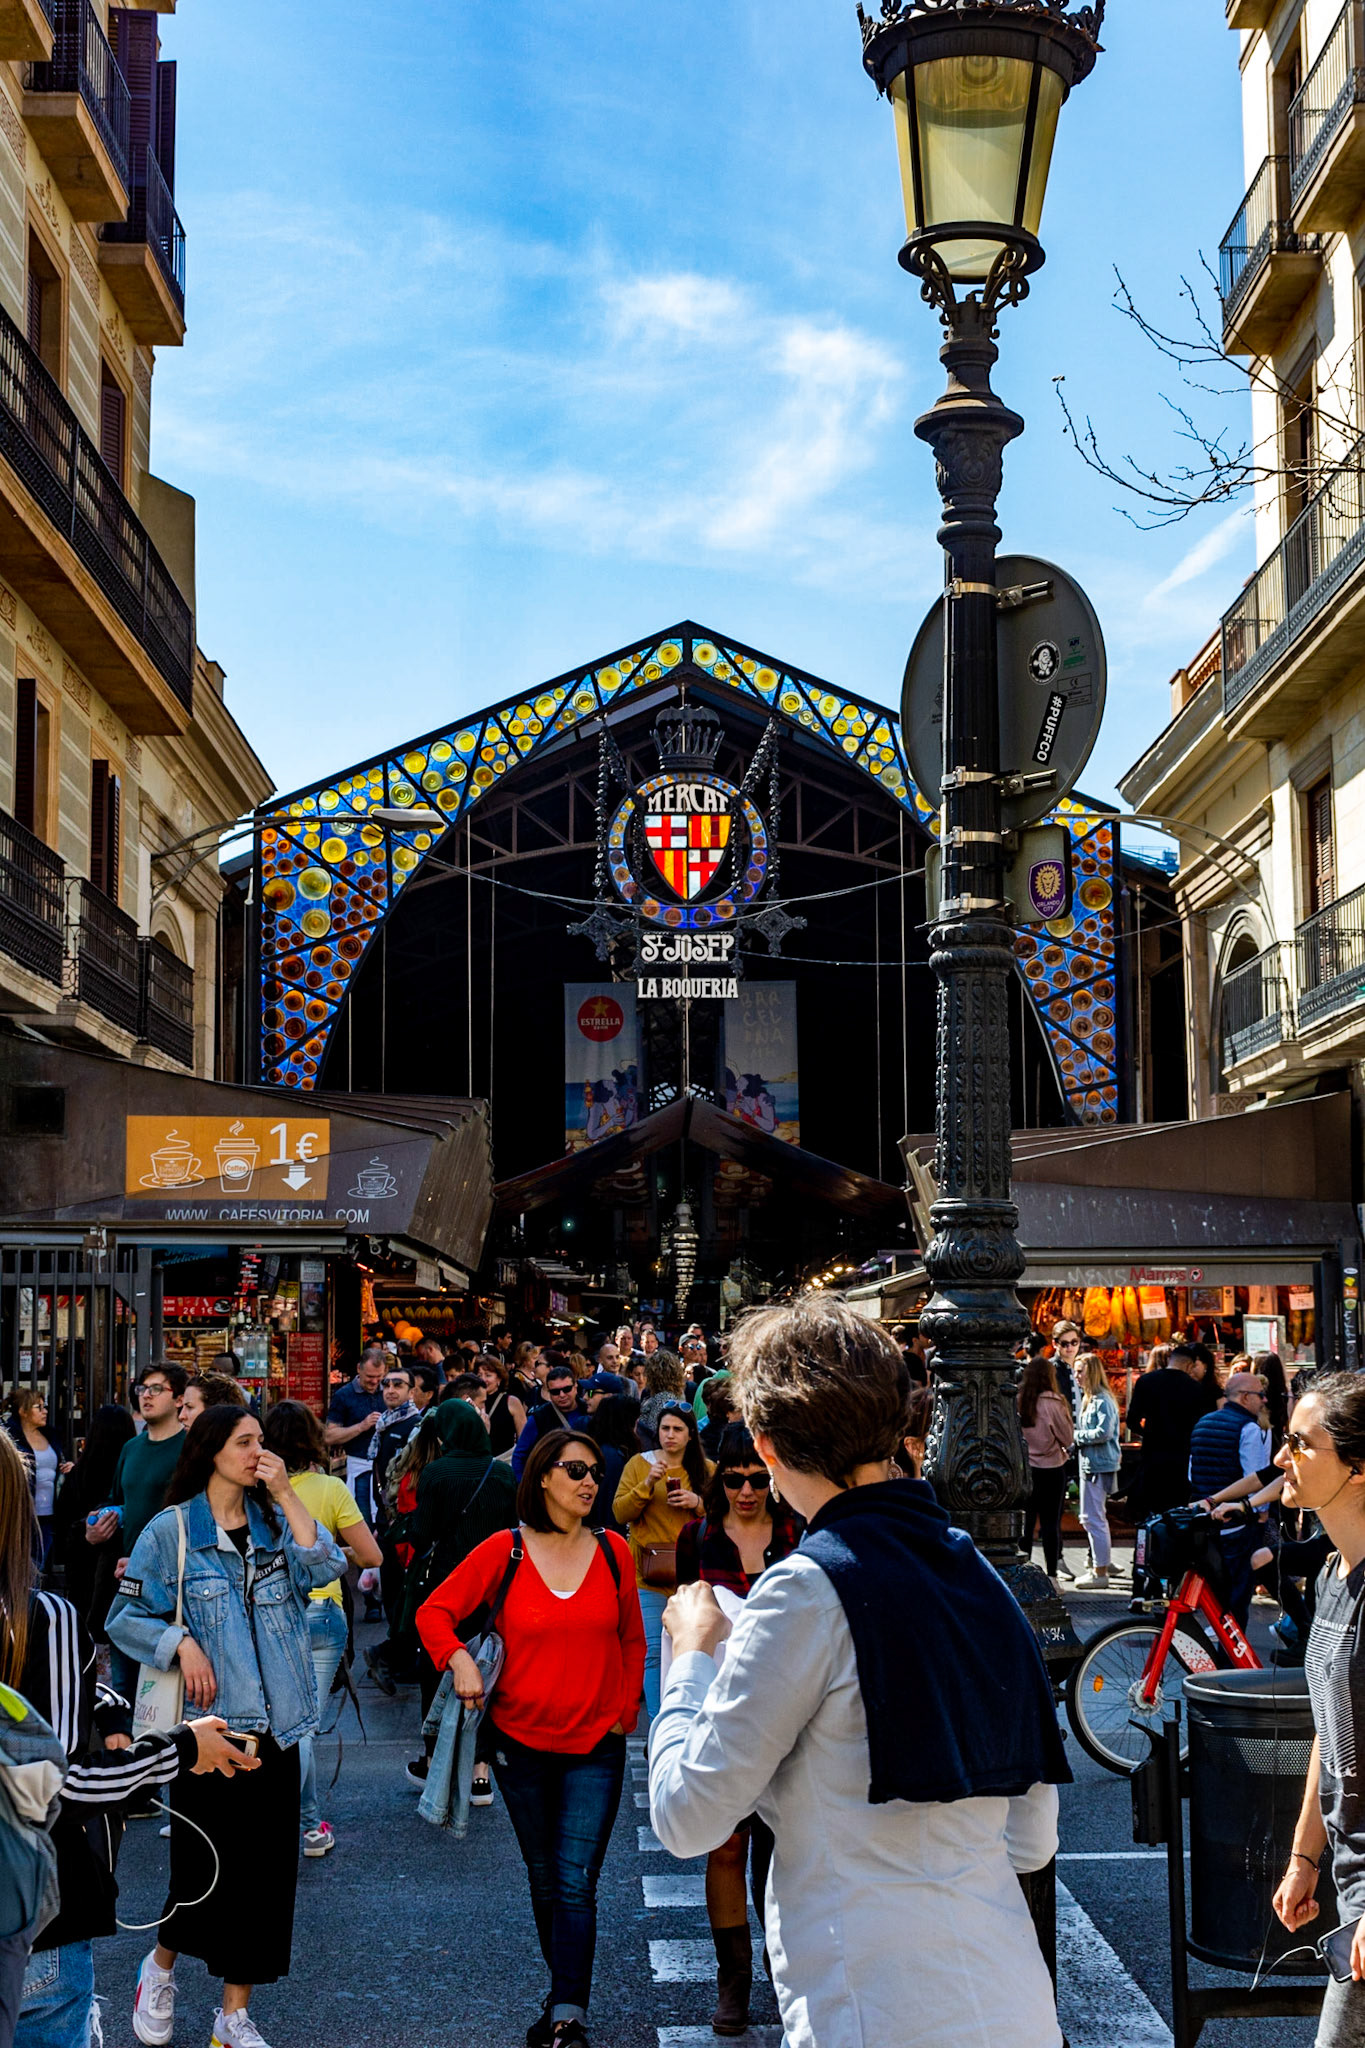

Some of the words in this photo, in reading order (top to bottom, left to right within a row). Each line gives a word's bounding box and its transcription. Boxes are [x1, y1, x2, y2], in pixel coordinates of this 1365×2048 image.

[1036, 695, 1063, 762] #PUFFCO
[648, 783, 729, 813] MERCAT
[1036, 900, 1061, 908] ORLANDO
[662, 934, 735, 962] JOSEP
[637, 978, 659, 998] LA
[661, 978, 739, 998] BOQUERIA
[580, 1017, 621, 1026] ESTRELLA
[335, 1208, 370, 1223] COM
[1129, 1266, 1187, 1282] Marcos
